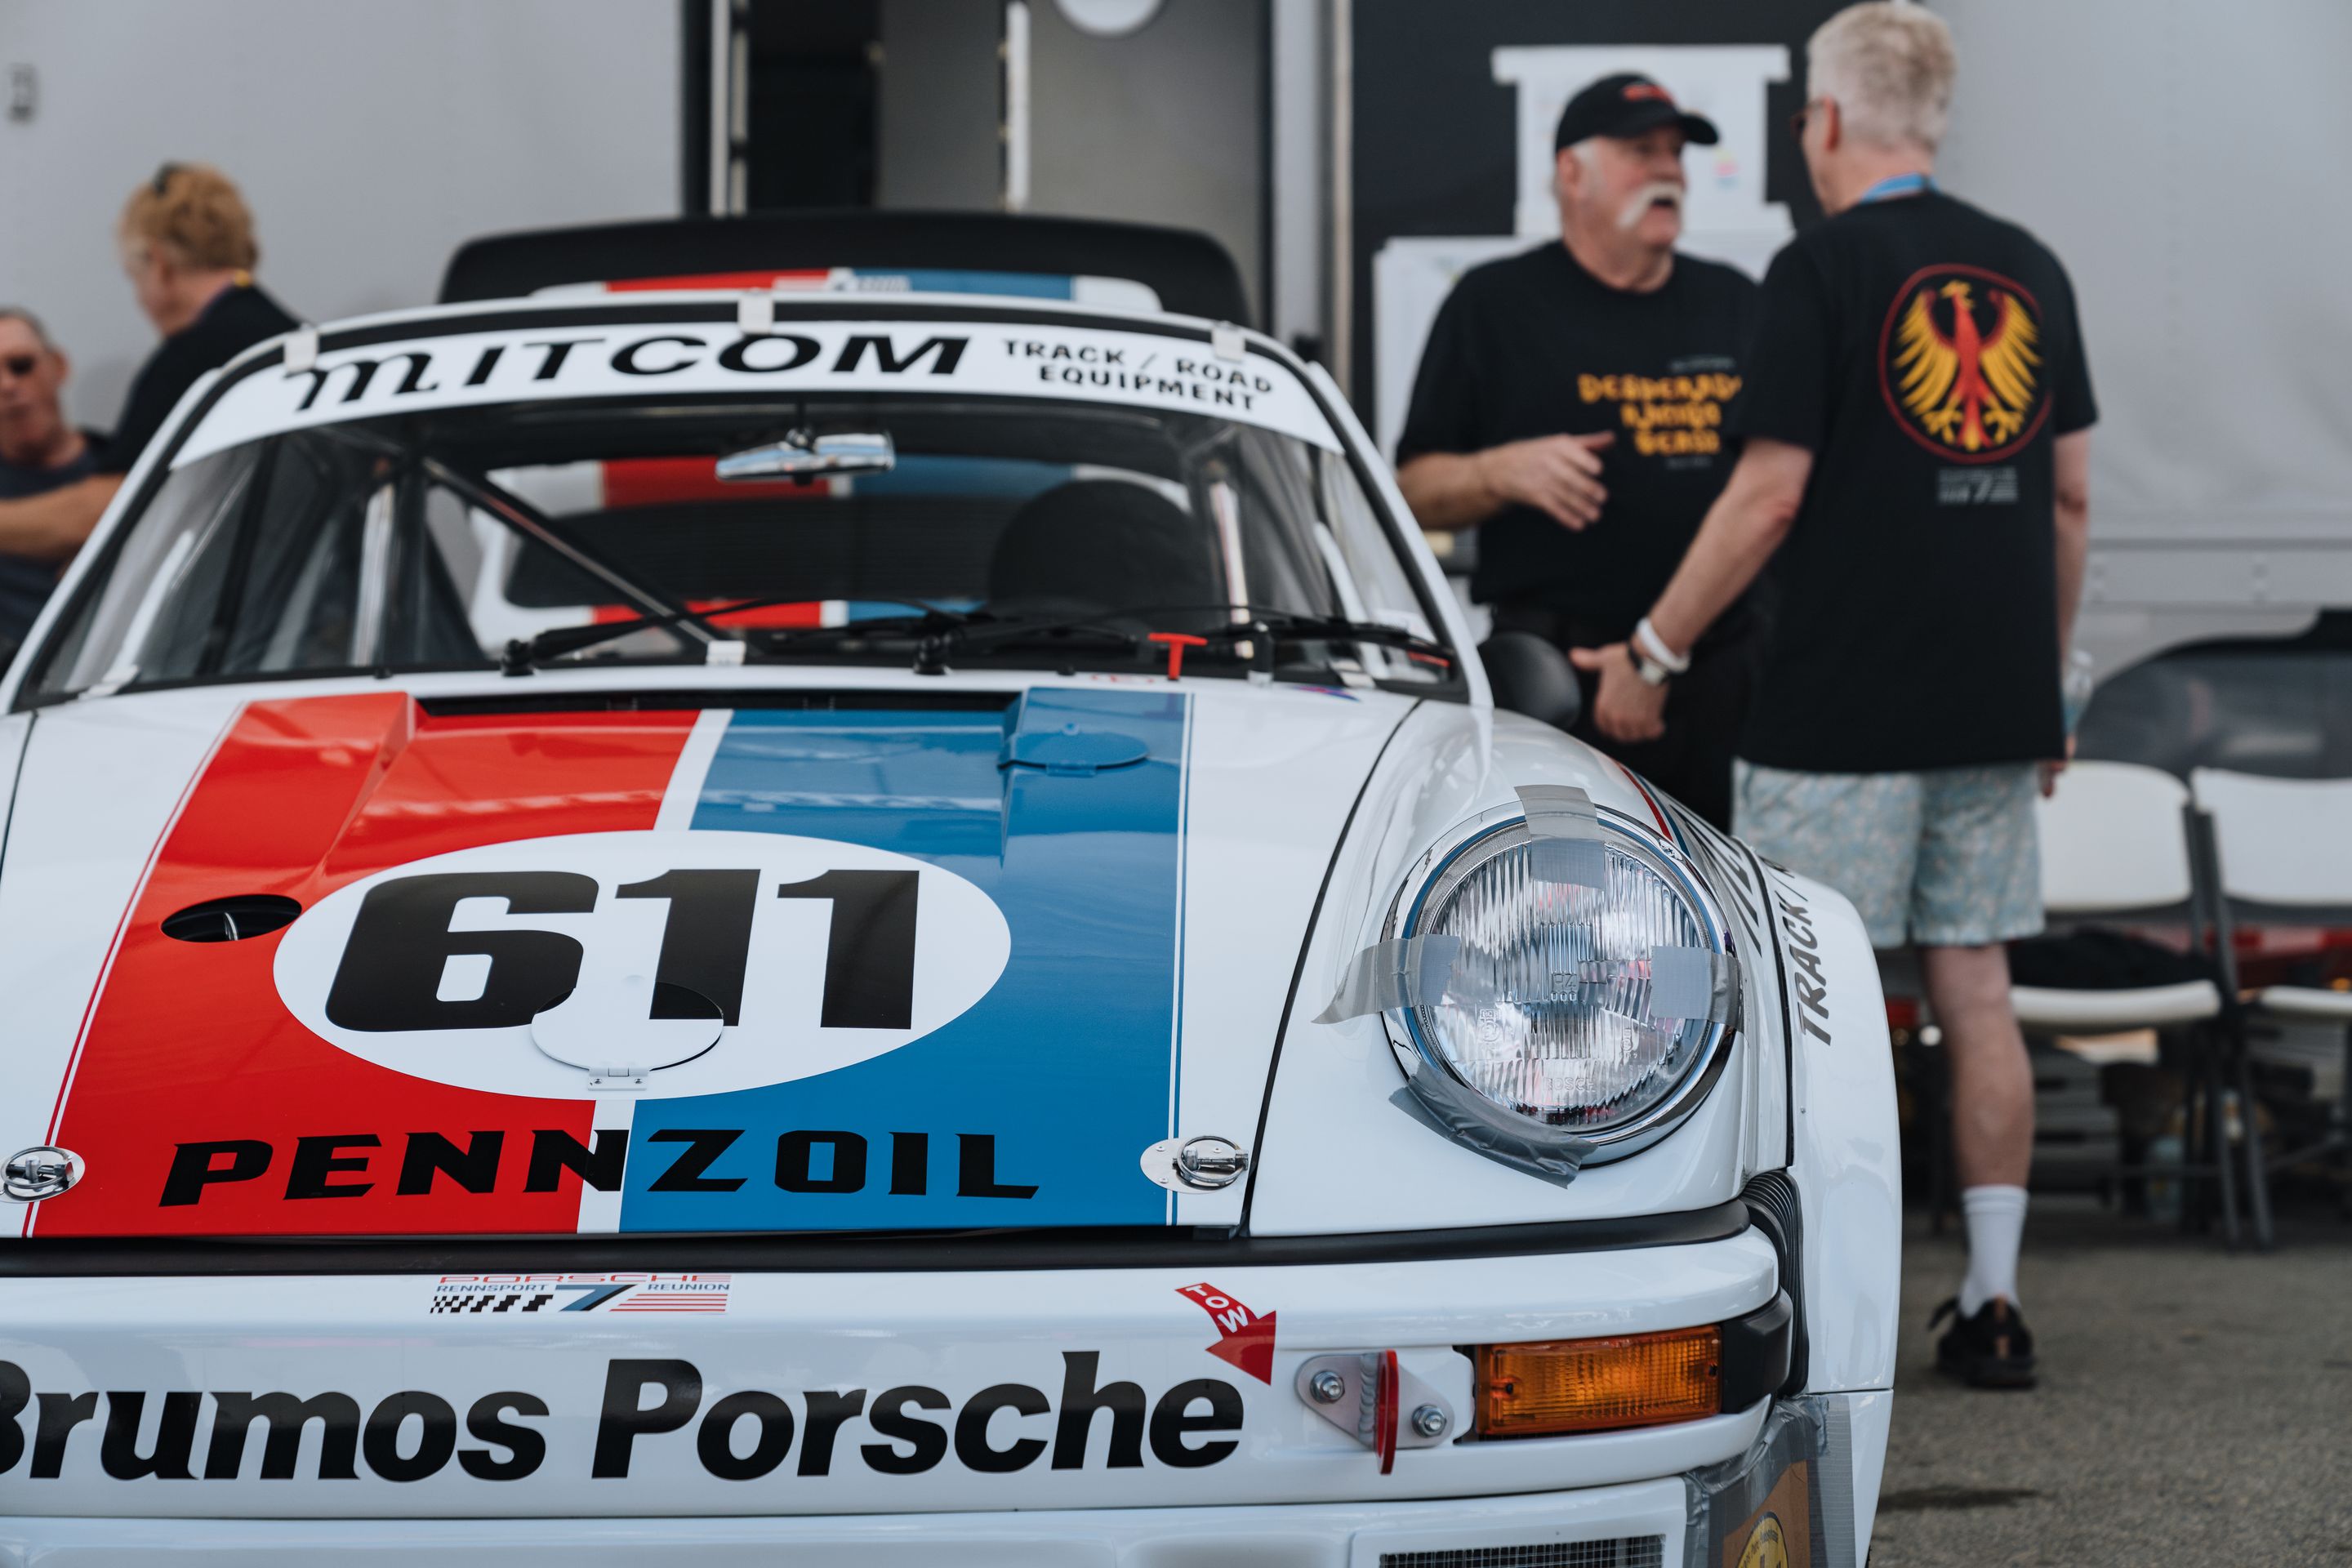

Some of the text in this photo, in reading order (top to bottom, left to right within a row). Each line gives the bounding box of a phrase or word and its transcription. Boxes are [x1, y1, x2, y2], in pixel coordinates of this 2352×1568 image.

[1004, 340, 1125, 364] TRACK
[1175, 359, 1272, 393] ROAD
[1040, 365, 1256, 411] EQUIPMENT
[325, 869, 920, 1032] 611
[1775, 890, 1831, 1046] TRACK
[158, 1129, 1039, 1207] PENNZOIL
[436, 1283, 730, 1312] RENNSPORT 7 REUNION
[439, 1274, 732, 1283] PORSCHE
[1186, 1285, 1249, 1333] TOW
[0, 1351, 1244, 1482] rumos Porsche
